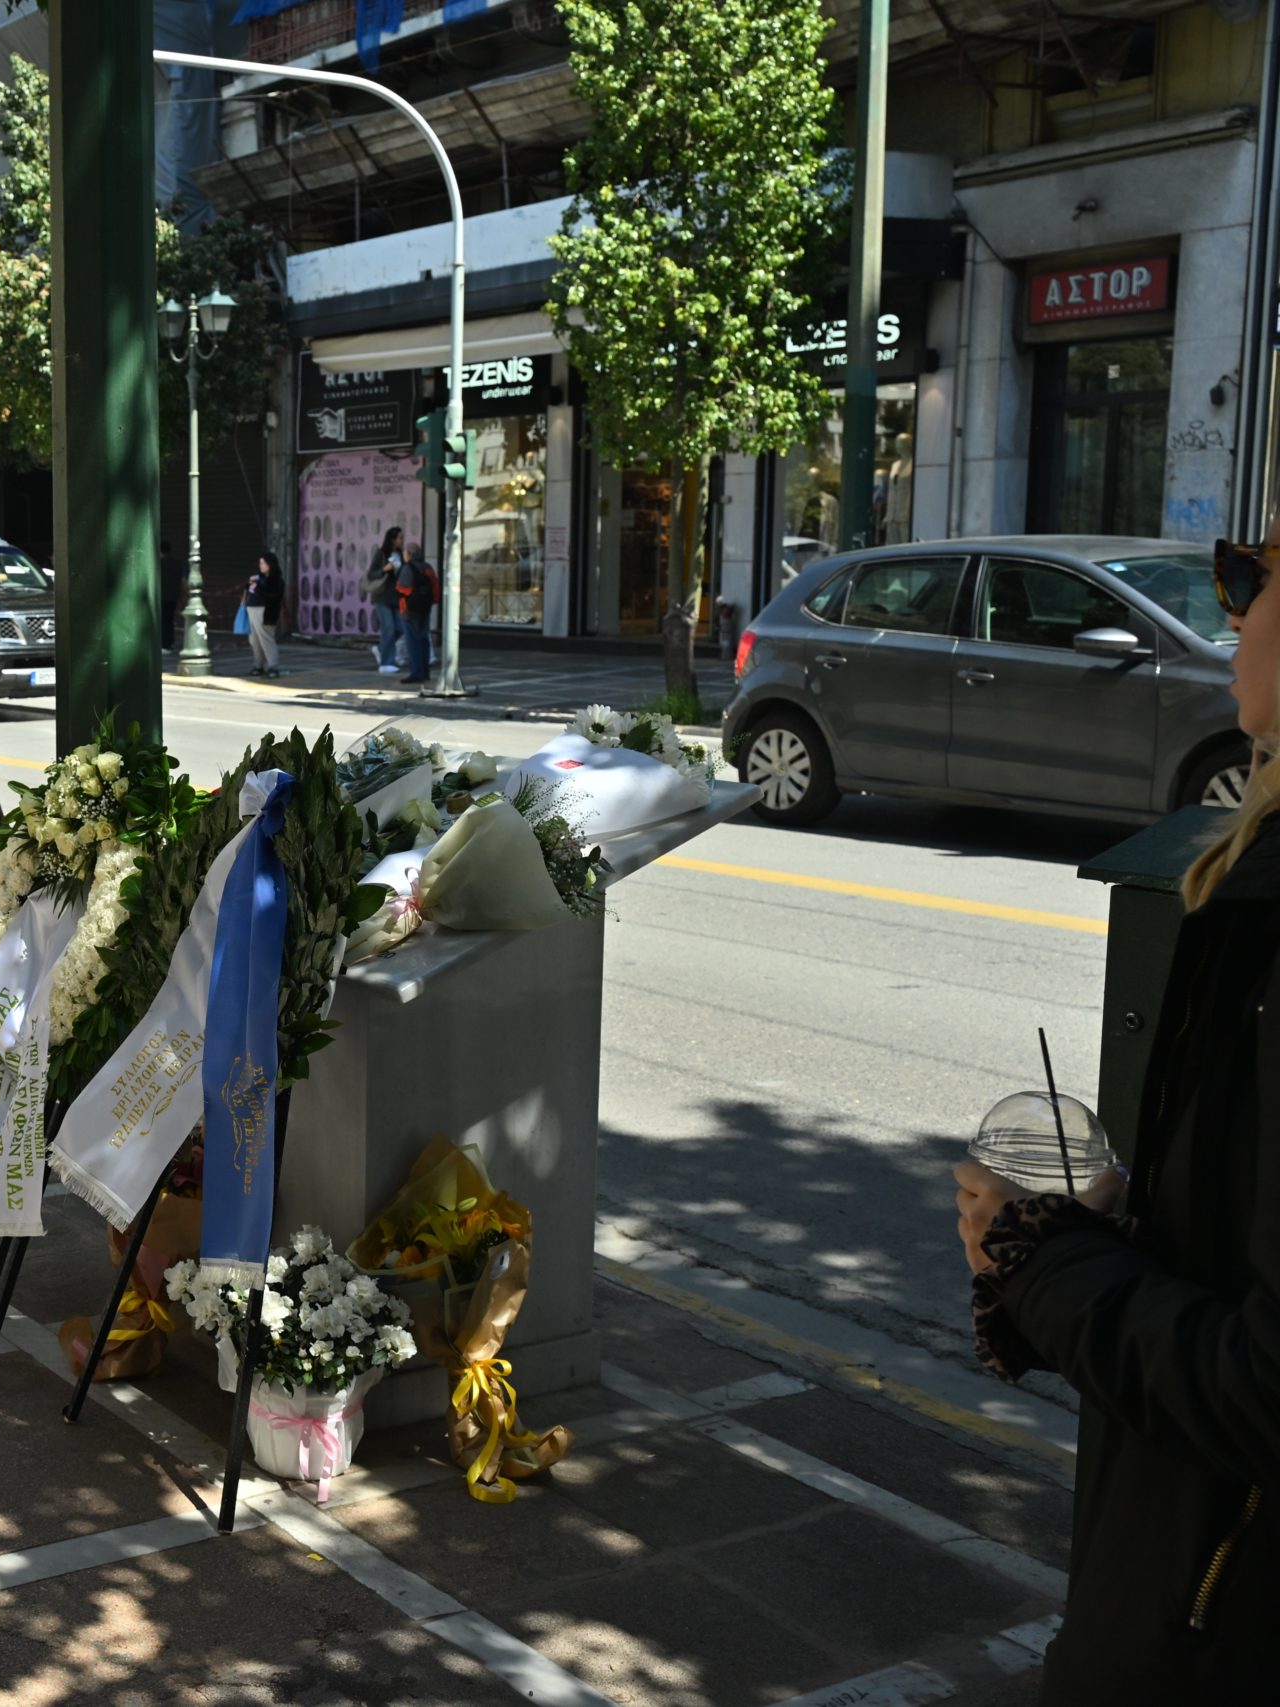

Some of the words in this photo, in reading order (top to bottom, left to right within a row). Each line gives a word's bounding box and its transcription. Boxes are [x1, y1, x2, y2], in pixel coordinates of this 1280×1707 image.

[1045, 266, 1151, 307] ΑΣΤΟΡ
[482, 385, 533, 399] underwear
[30, 1041, 39, 1066] ΤΩΝ
[110, 1030, 168, 1096] ΣΥΛΛΟΓΟΣ
[111, 1030, 191, 1119] ΕΡΓΑΖΟΜΕΝΩΝ
[35, 1112, 45, 1159] ΜΝΗΜΗ
[109, 1081, 162, 1149] ΤΡΑΠΕΖΑΣ
[7, 1163, 23, 1210] ΜΑΣ
